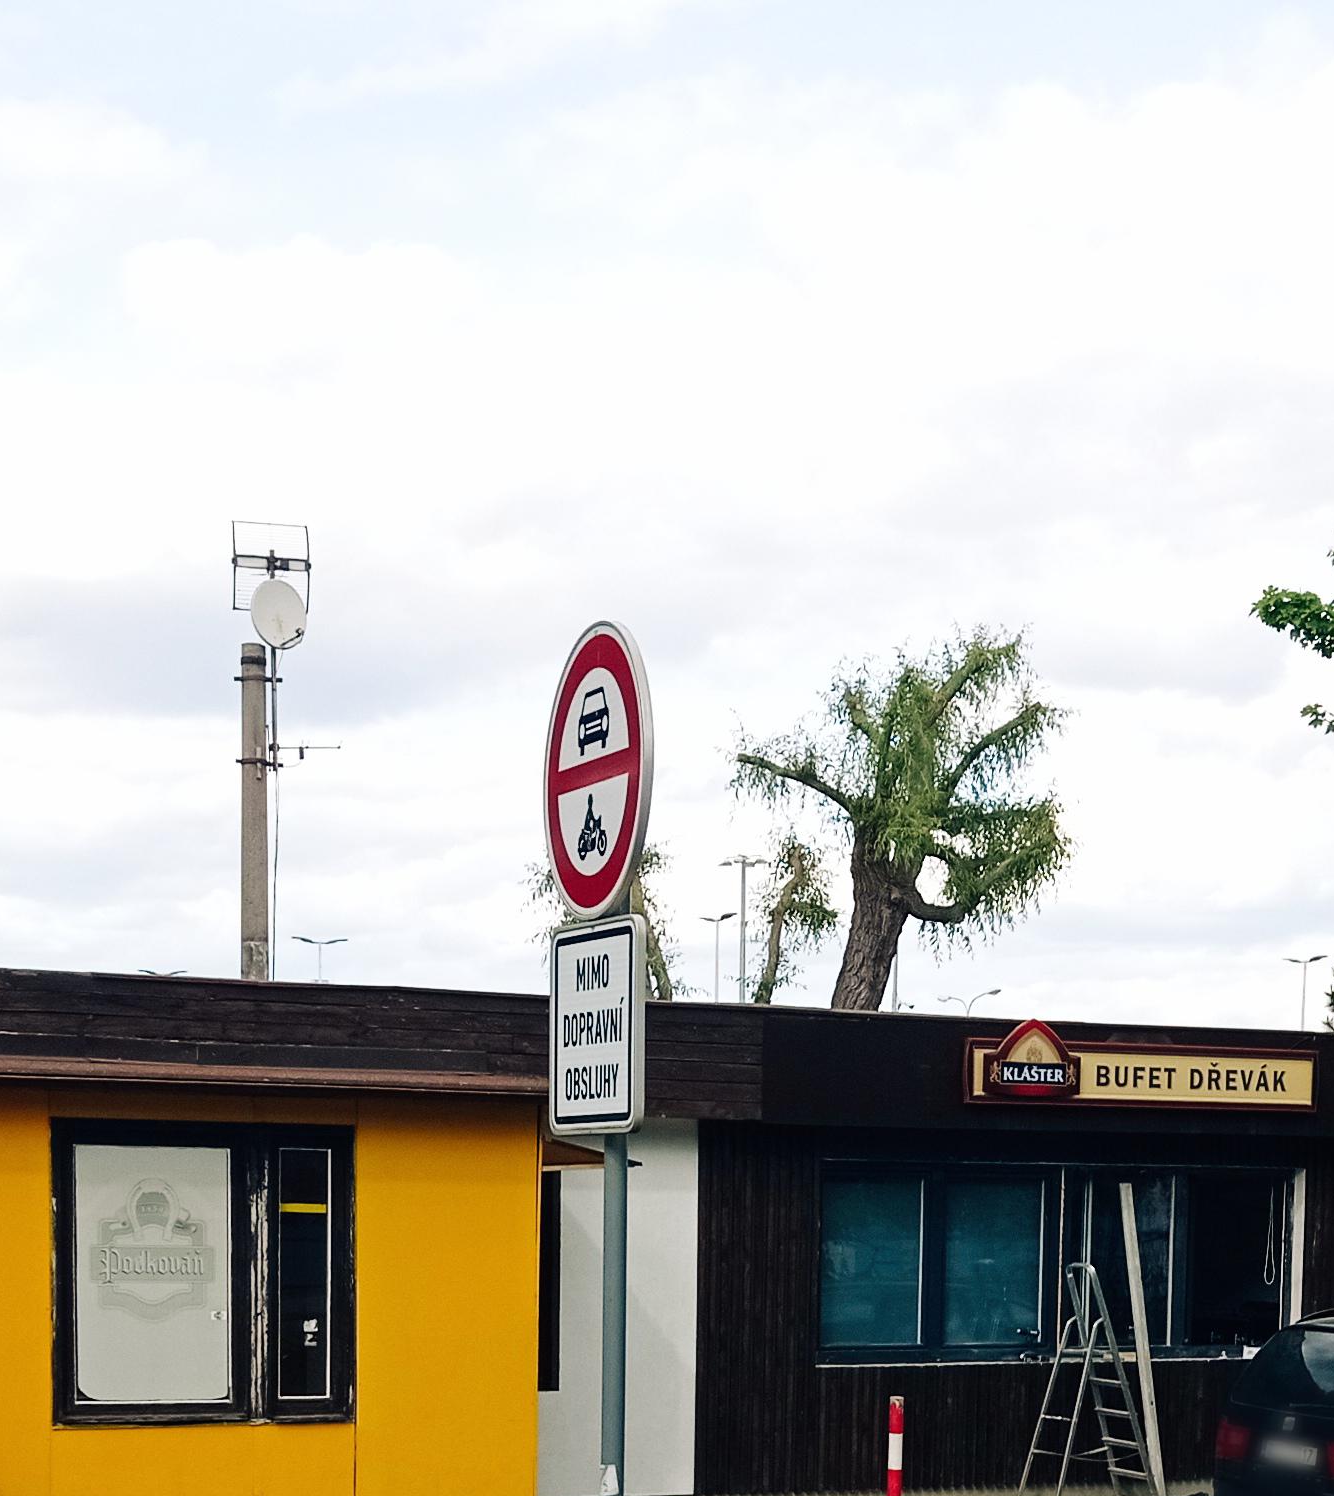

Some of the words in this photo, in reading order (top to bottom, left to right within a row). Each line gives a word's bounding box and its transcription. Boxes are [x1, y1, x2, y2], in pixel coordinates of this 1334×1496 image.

[575, 954, 609, 992] MIMO
[563, 997, 624, 1048] DOPRAVNÍ
[565, 1063, 619, 1101] OBSLUHY
[1003, 1064, 1064, 1083] KLÁŠTER
[1096, 1065, 1177, 1090] BUFET
[1189, 1062, 1287, 1092] DŘEVÁK
